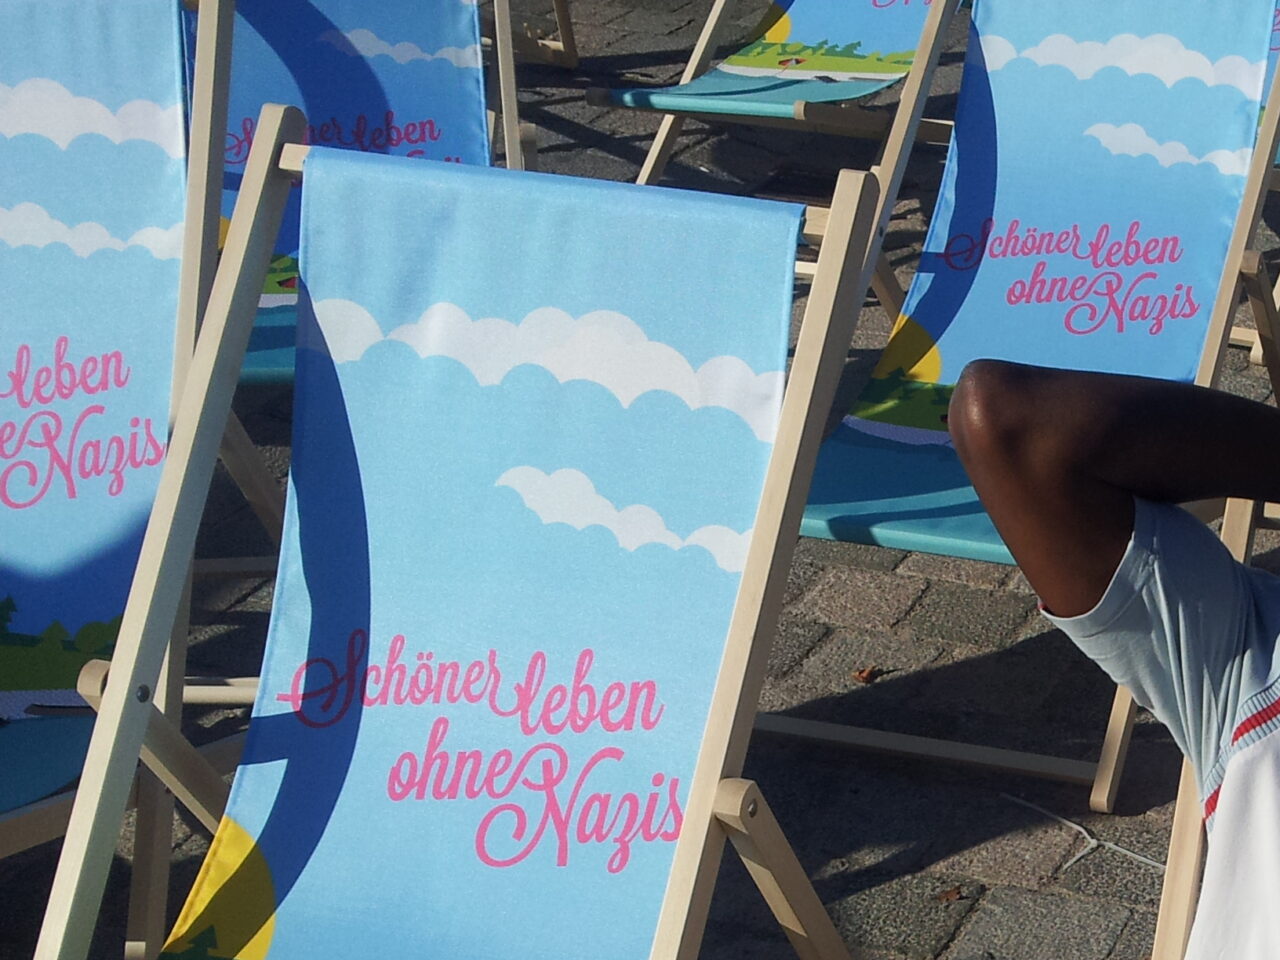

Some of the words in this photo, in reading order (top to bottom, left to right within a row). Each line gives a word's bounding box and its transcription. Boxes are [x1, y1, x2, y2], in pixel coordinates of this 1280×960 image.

[351, 110, 441, 151] leben
[936, 217, 1091, 271] Schöner
[1089, 221, 1184, 269] leben
[1006, 261, 1092, 306] ohne
[1064, 271, 1200, 336] Nazis
[7, 336, 131, 409] leben
[0, 404, 168, 510] Nazis
[276, 628, 517, 729] Schöner
[514, 648, 664, 736] leben
[387, 716, 524, 802] ohne
[475, 742, 684, 874] Nazis
